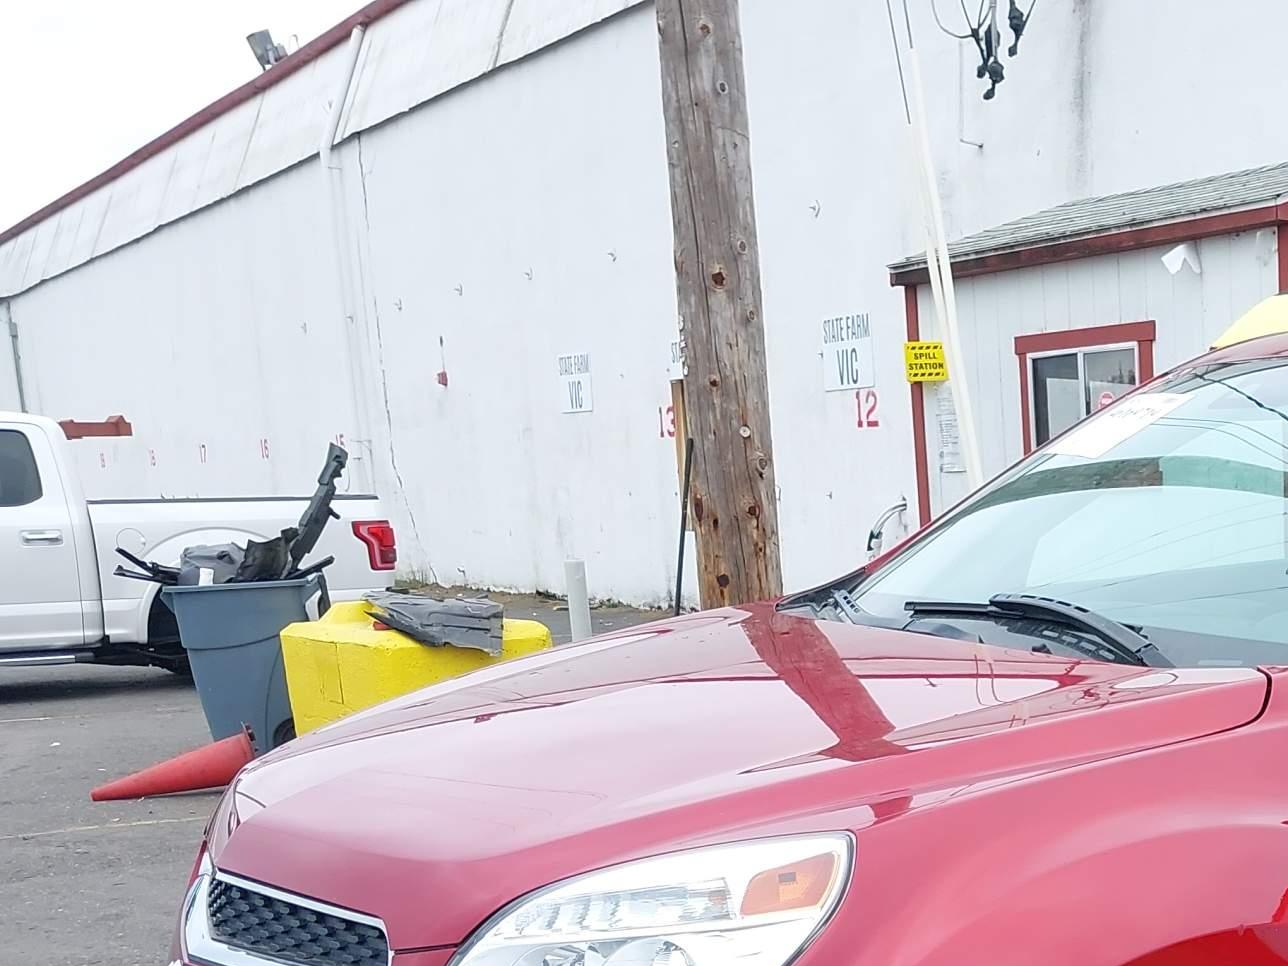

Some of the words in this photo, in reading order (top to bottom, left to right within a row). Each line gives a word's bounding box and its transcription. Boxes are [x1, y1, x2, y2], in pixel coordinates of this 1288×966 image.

[823, 317, 845, 344] STATE
[846, 312, 870, 340] FARM
[837, 347, 859, 386] VIC
[908, 362, 944, 371] STATION
[913, 352, 937, 360] SPILL
[568, 380, 583, 409] VIC
[855, 390, 879, 428] 12
